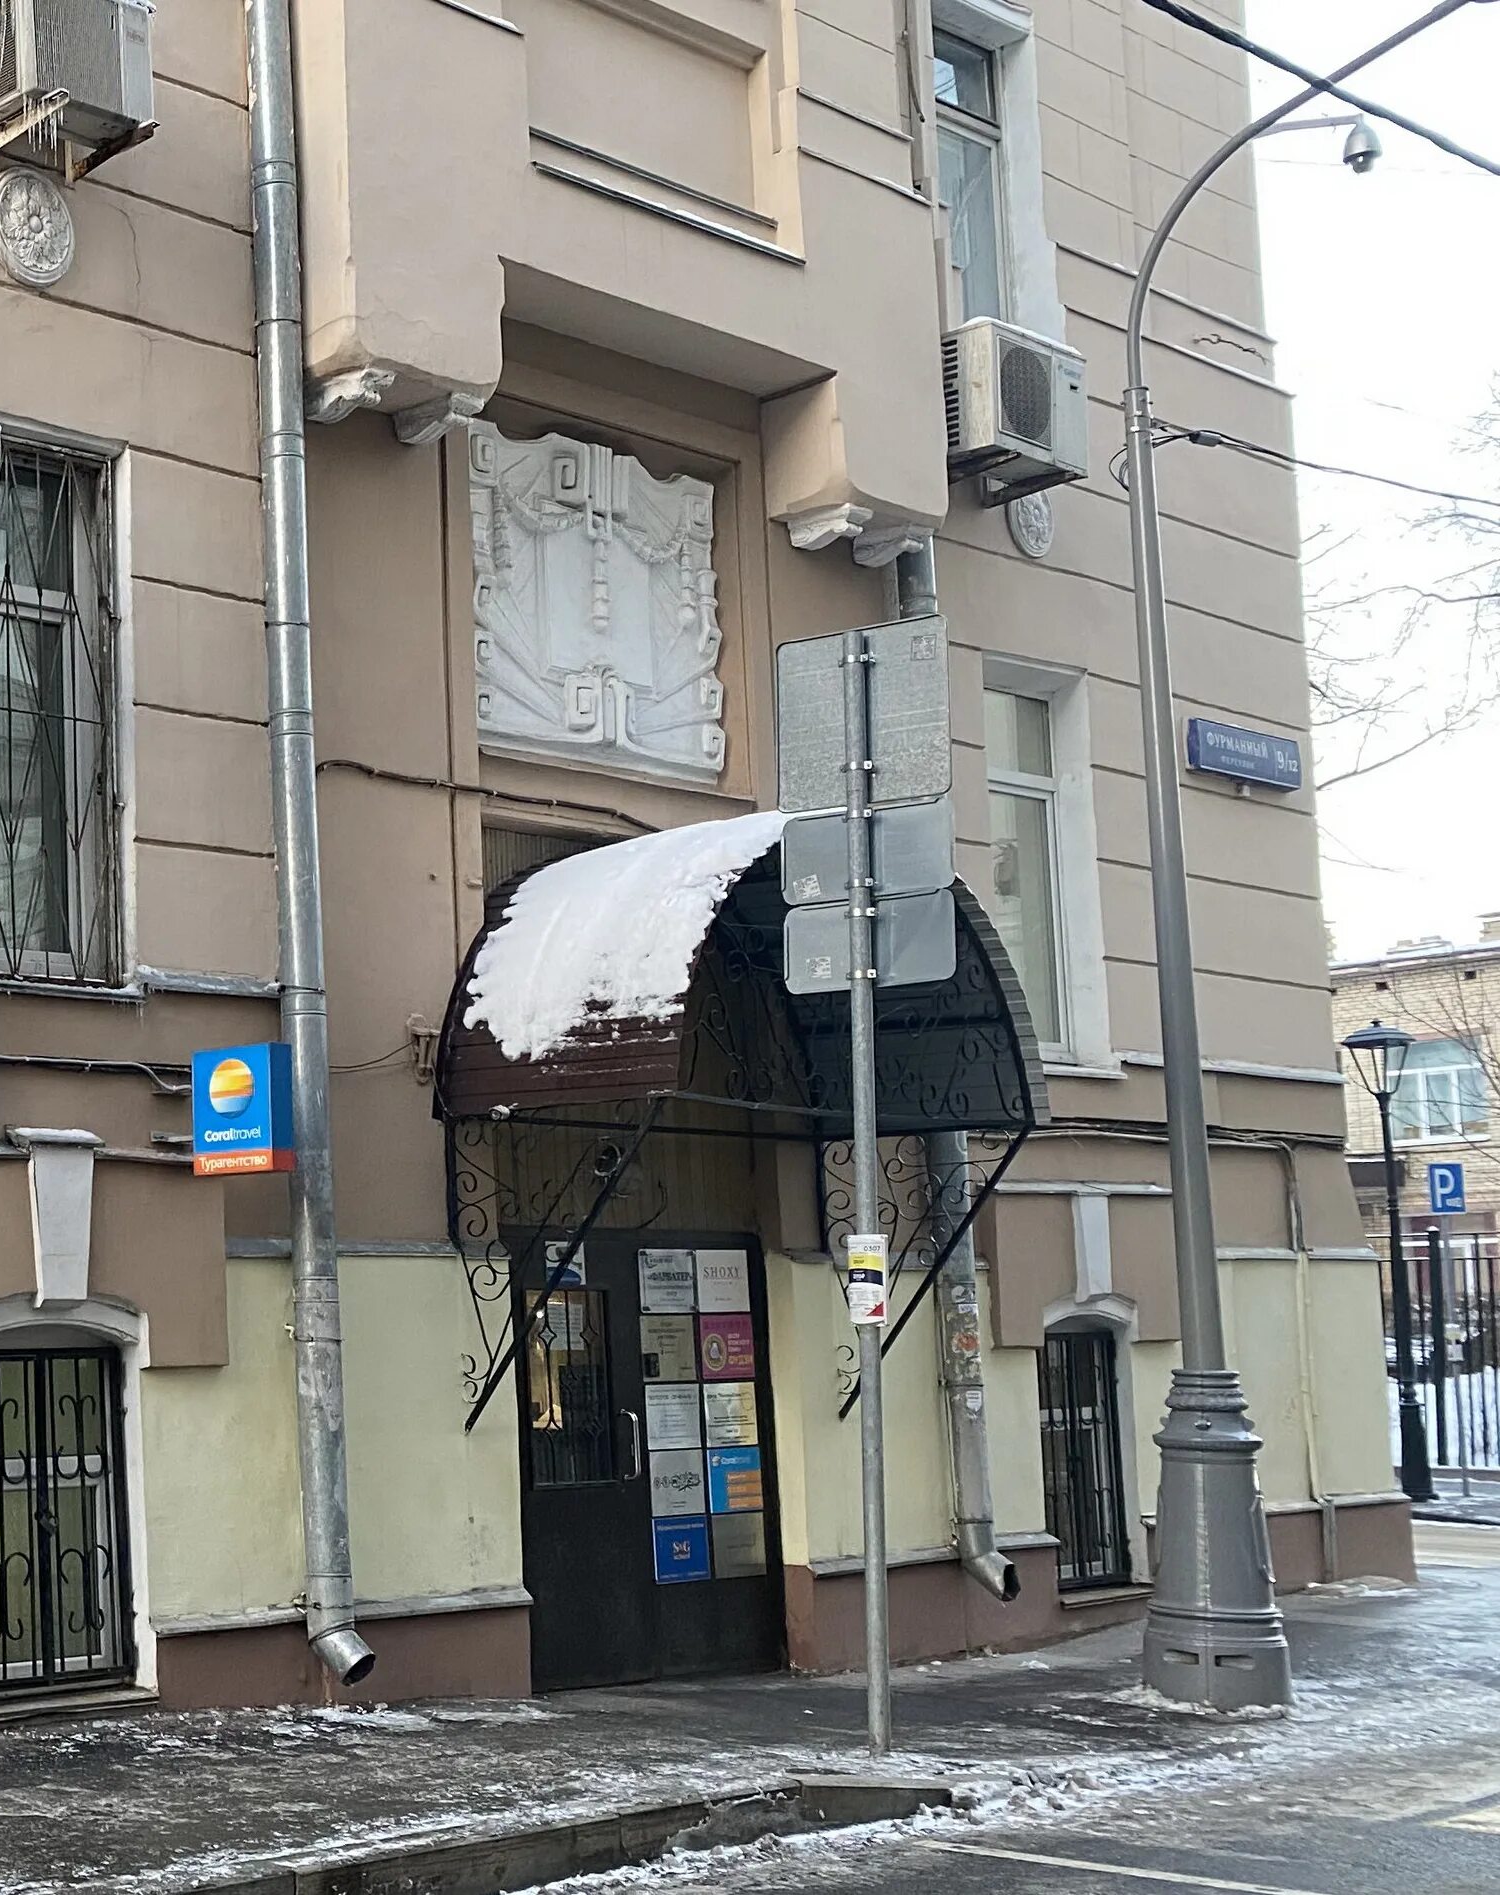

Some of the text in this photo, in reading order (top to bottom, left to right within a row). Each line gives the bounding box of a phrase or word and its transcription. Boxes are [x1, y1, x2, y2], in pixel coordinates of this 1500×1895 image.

[1206, 731, 1269, 759] ФУРМАННЫЙ
[198, 1155, 268, 1171] Турагентство
[1434, 1168, 1455, 1208] P
